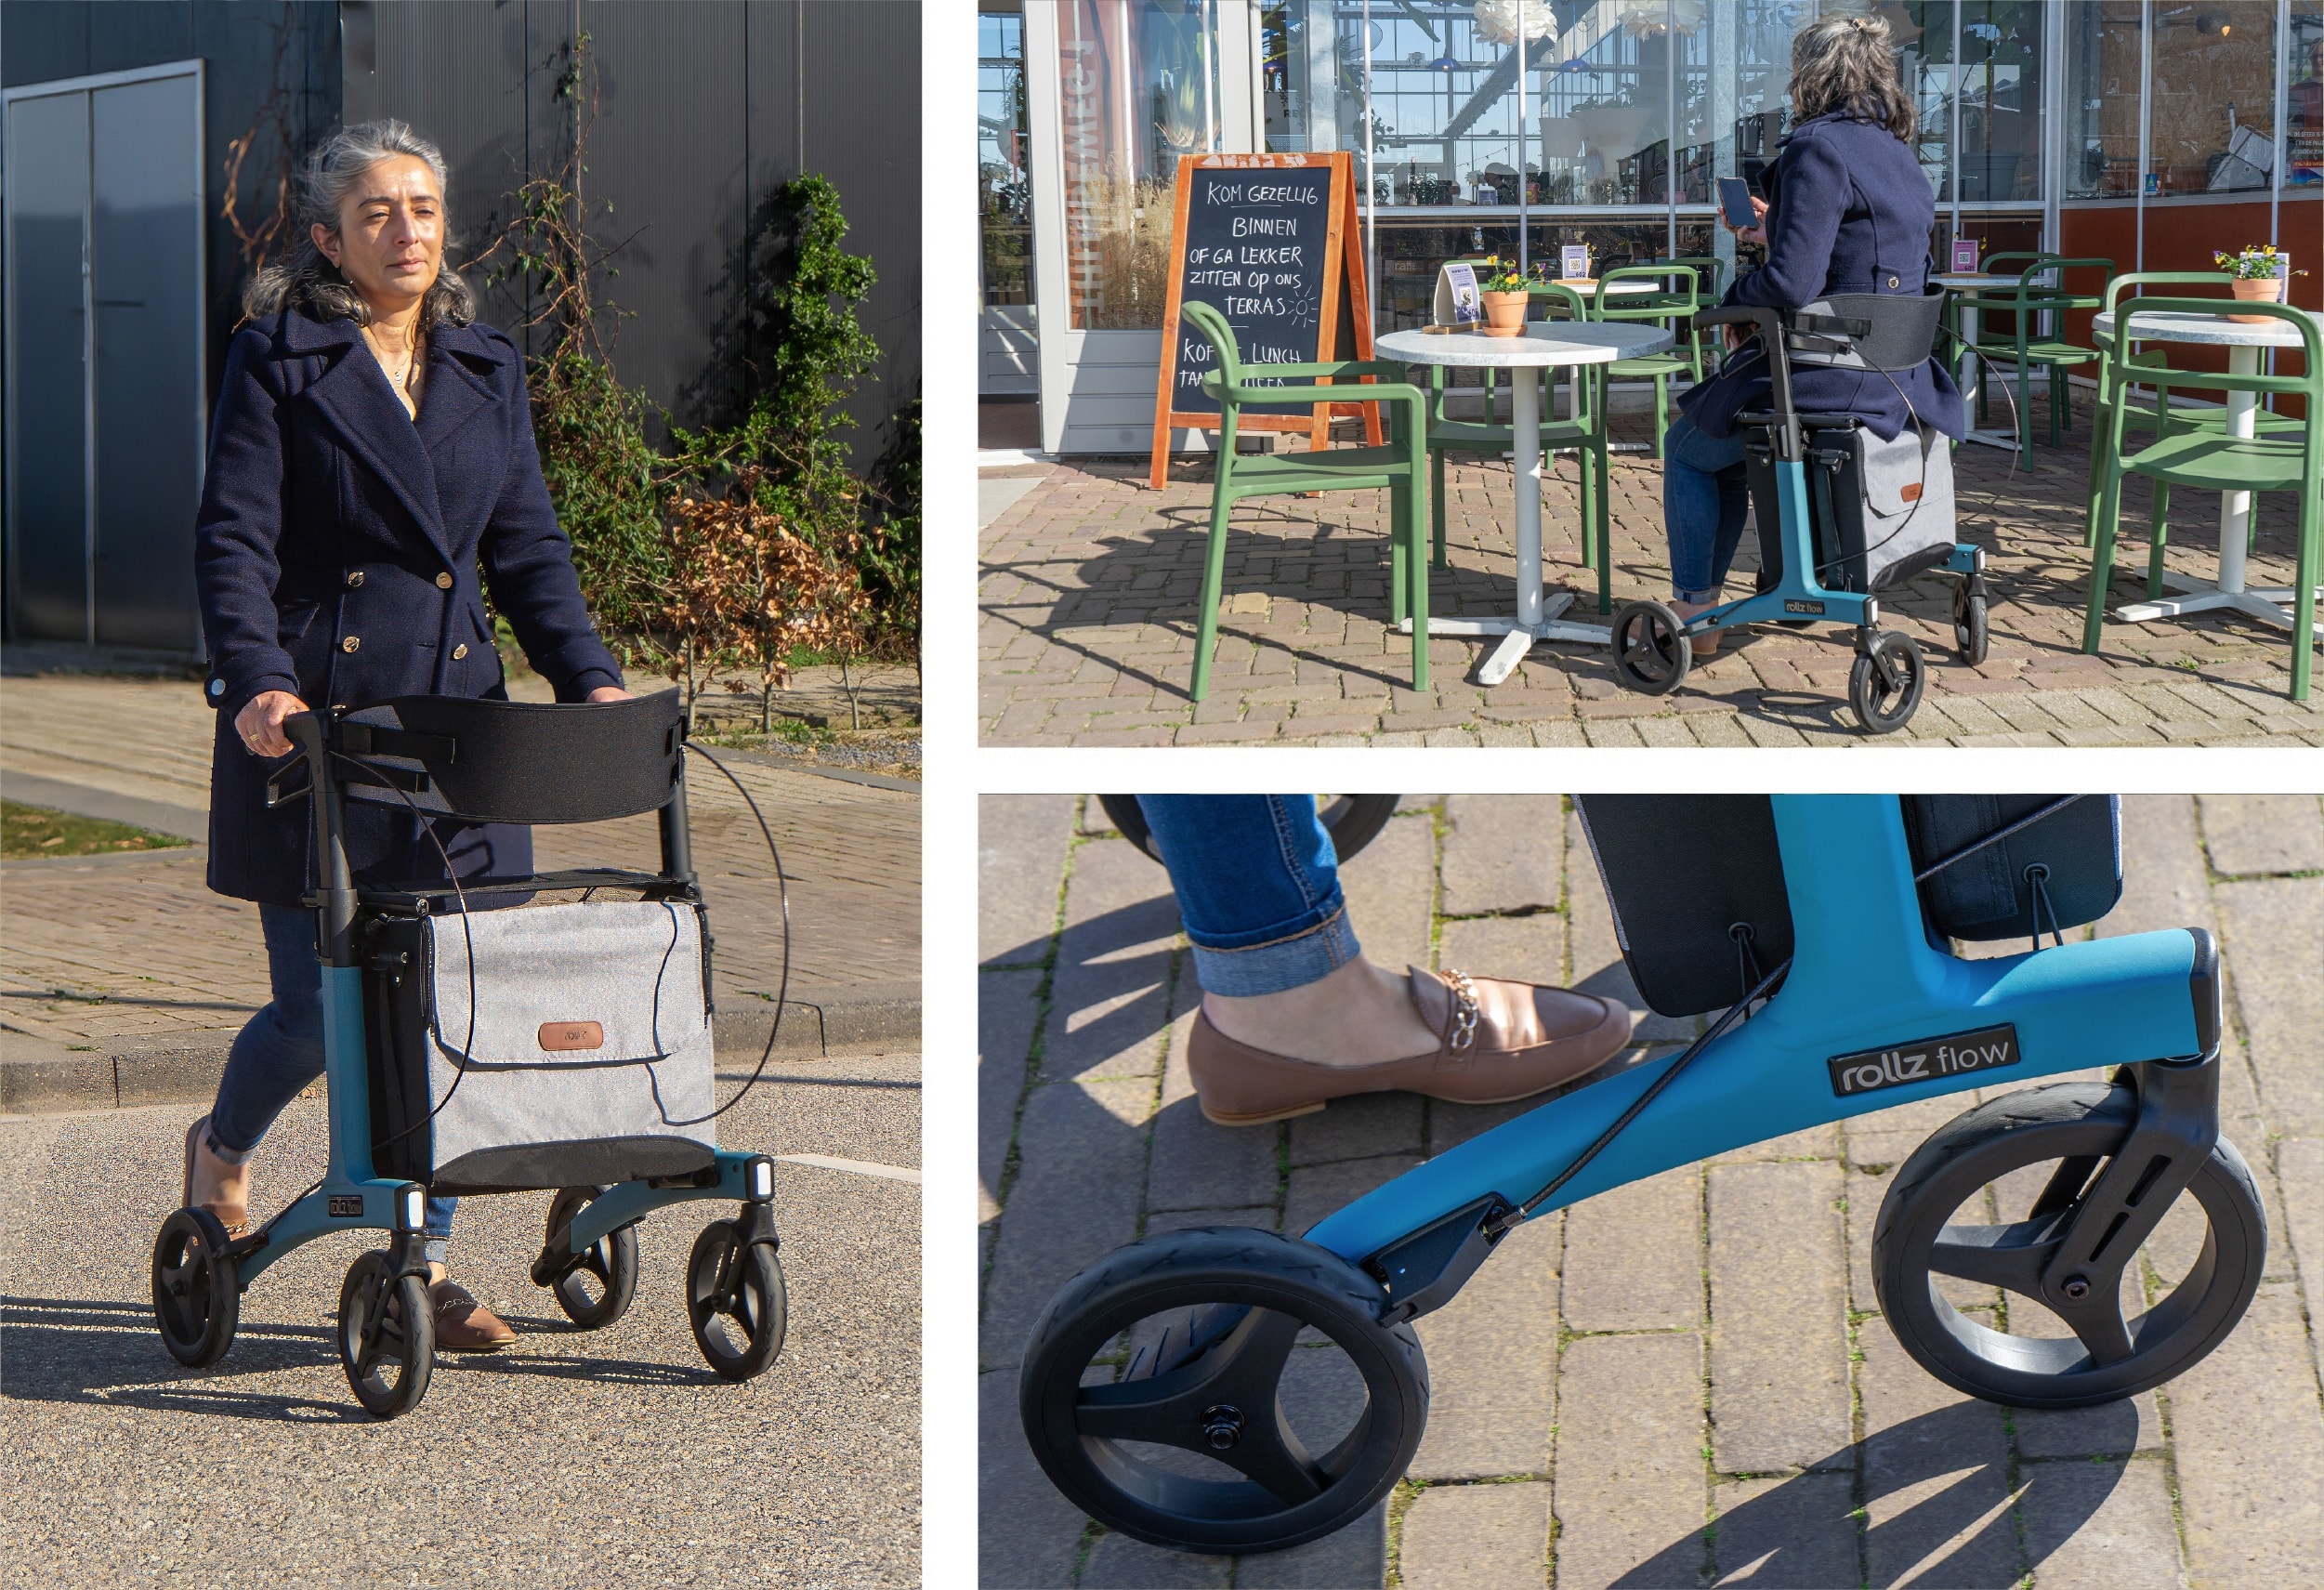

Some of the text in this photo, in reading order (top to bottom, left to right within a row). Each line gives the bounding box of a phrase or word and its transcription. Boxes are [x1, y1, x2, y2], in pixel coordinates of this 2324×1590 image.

[1207, 181, 1319, 205] KOM GEZELLIG
[1232, 217, 1297, 237] BINNEN
[1189, 245, 1303, 267] OF GA LEKKER
[1189, 270, 1241, 286] ZITTEN
[1275, 273, 1302, 289] ONS
[1224, 296, 1286, 316] TERRAS
[1253, 343, 1302, 364] LUNCH
[1786, 601, 1823, 613] rollz flow
[1842, 1042, 2009, 1091] rollz flow
